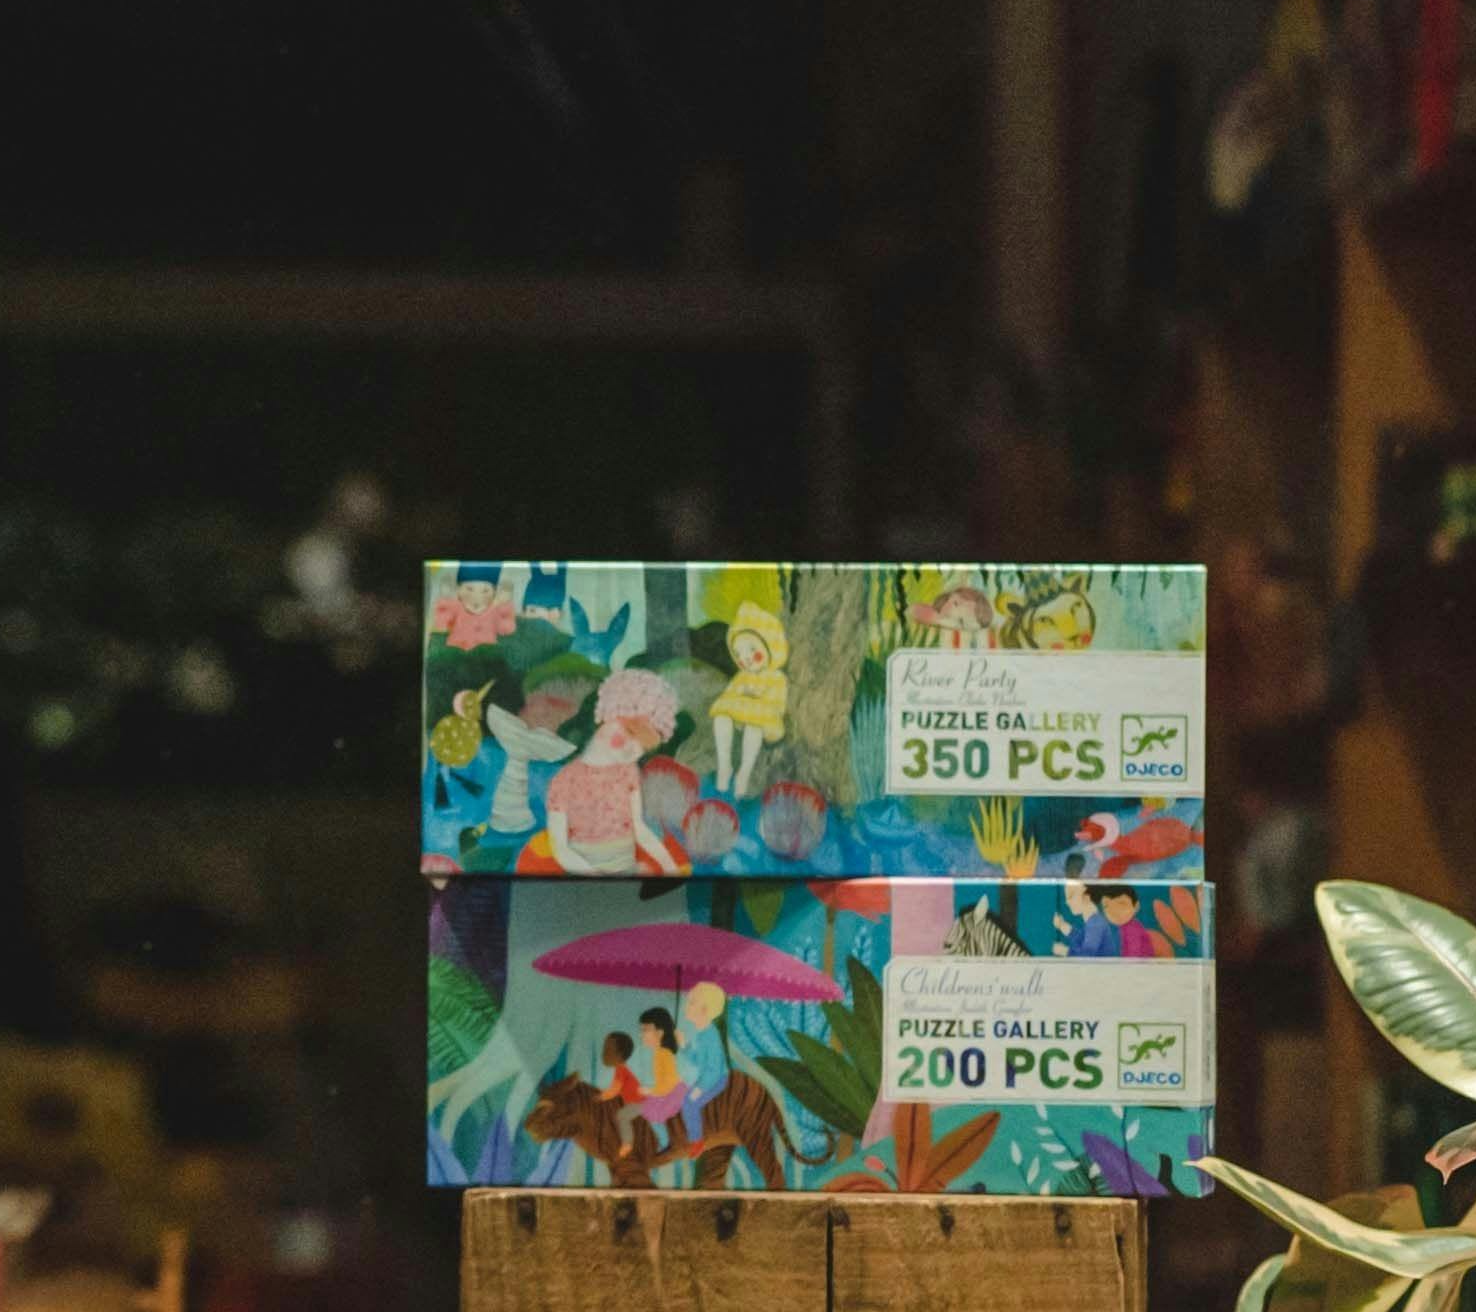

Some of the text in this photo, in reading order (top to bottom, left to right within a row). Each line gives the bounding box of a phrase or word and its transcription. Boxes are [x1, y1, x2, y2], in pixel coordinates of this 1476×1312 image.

[901, 657, 1018, 692] River Party
[901, 711, 1101, 732] PUZZLE GALLERY
[901, 738, 1106, 781] 350 PCS
[1125, 762, 1184, 777] DJECO
[899, 1019, 1100, 1039] PUZZLE GALLERY
[898, 1046, 1104, 1090] 200 PCS
[1122, 1071, 1182, 1086] DJECO
